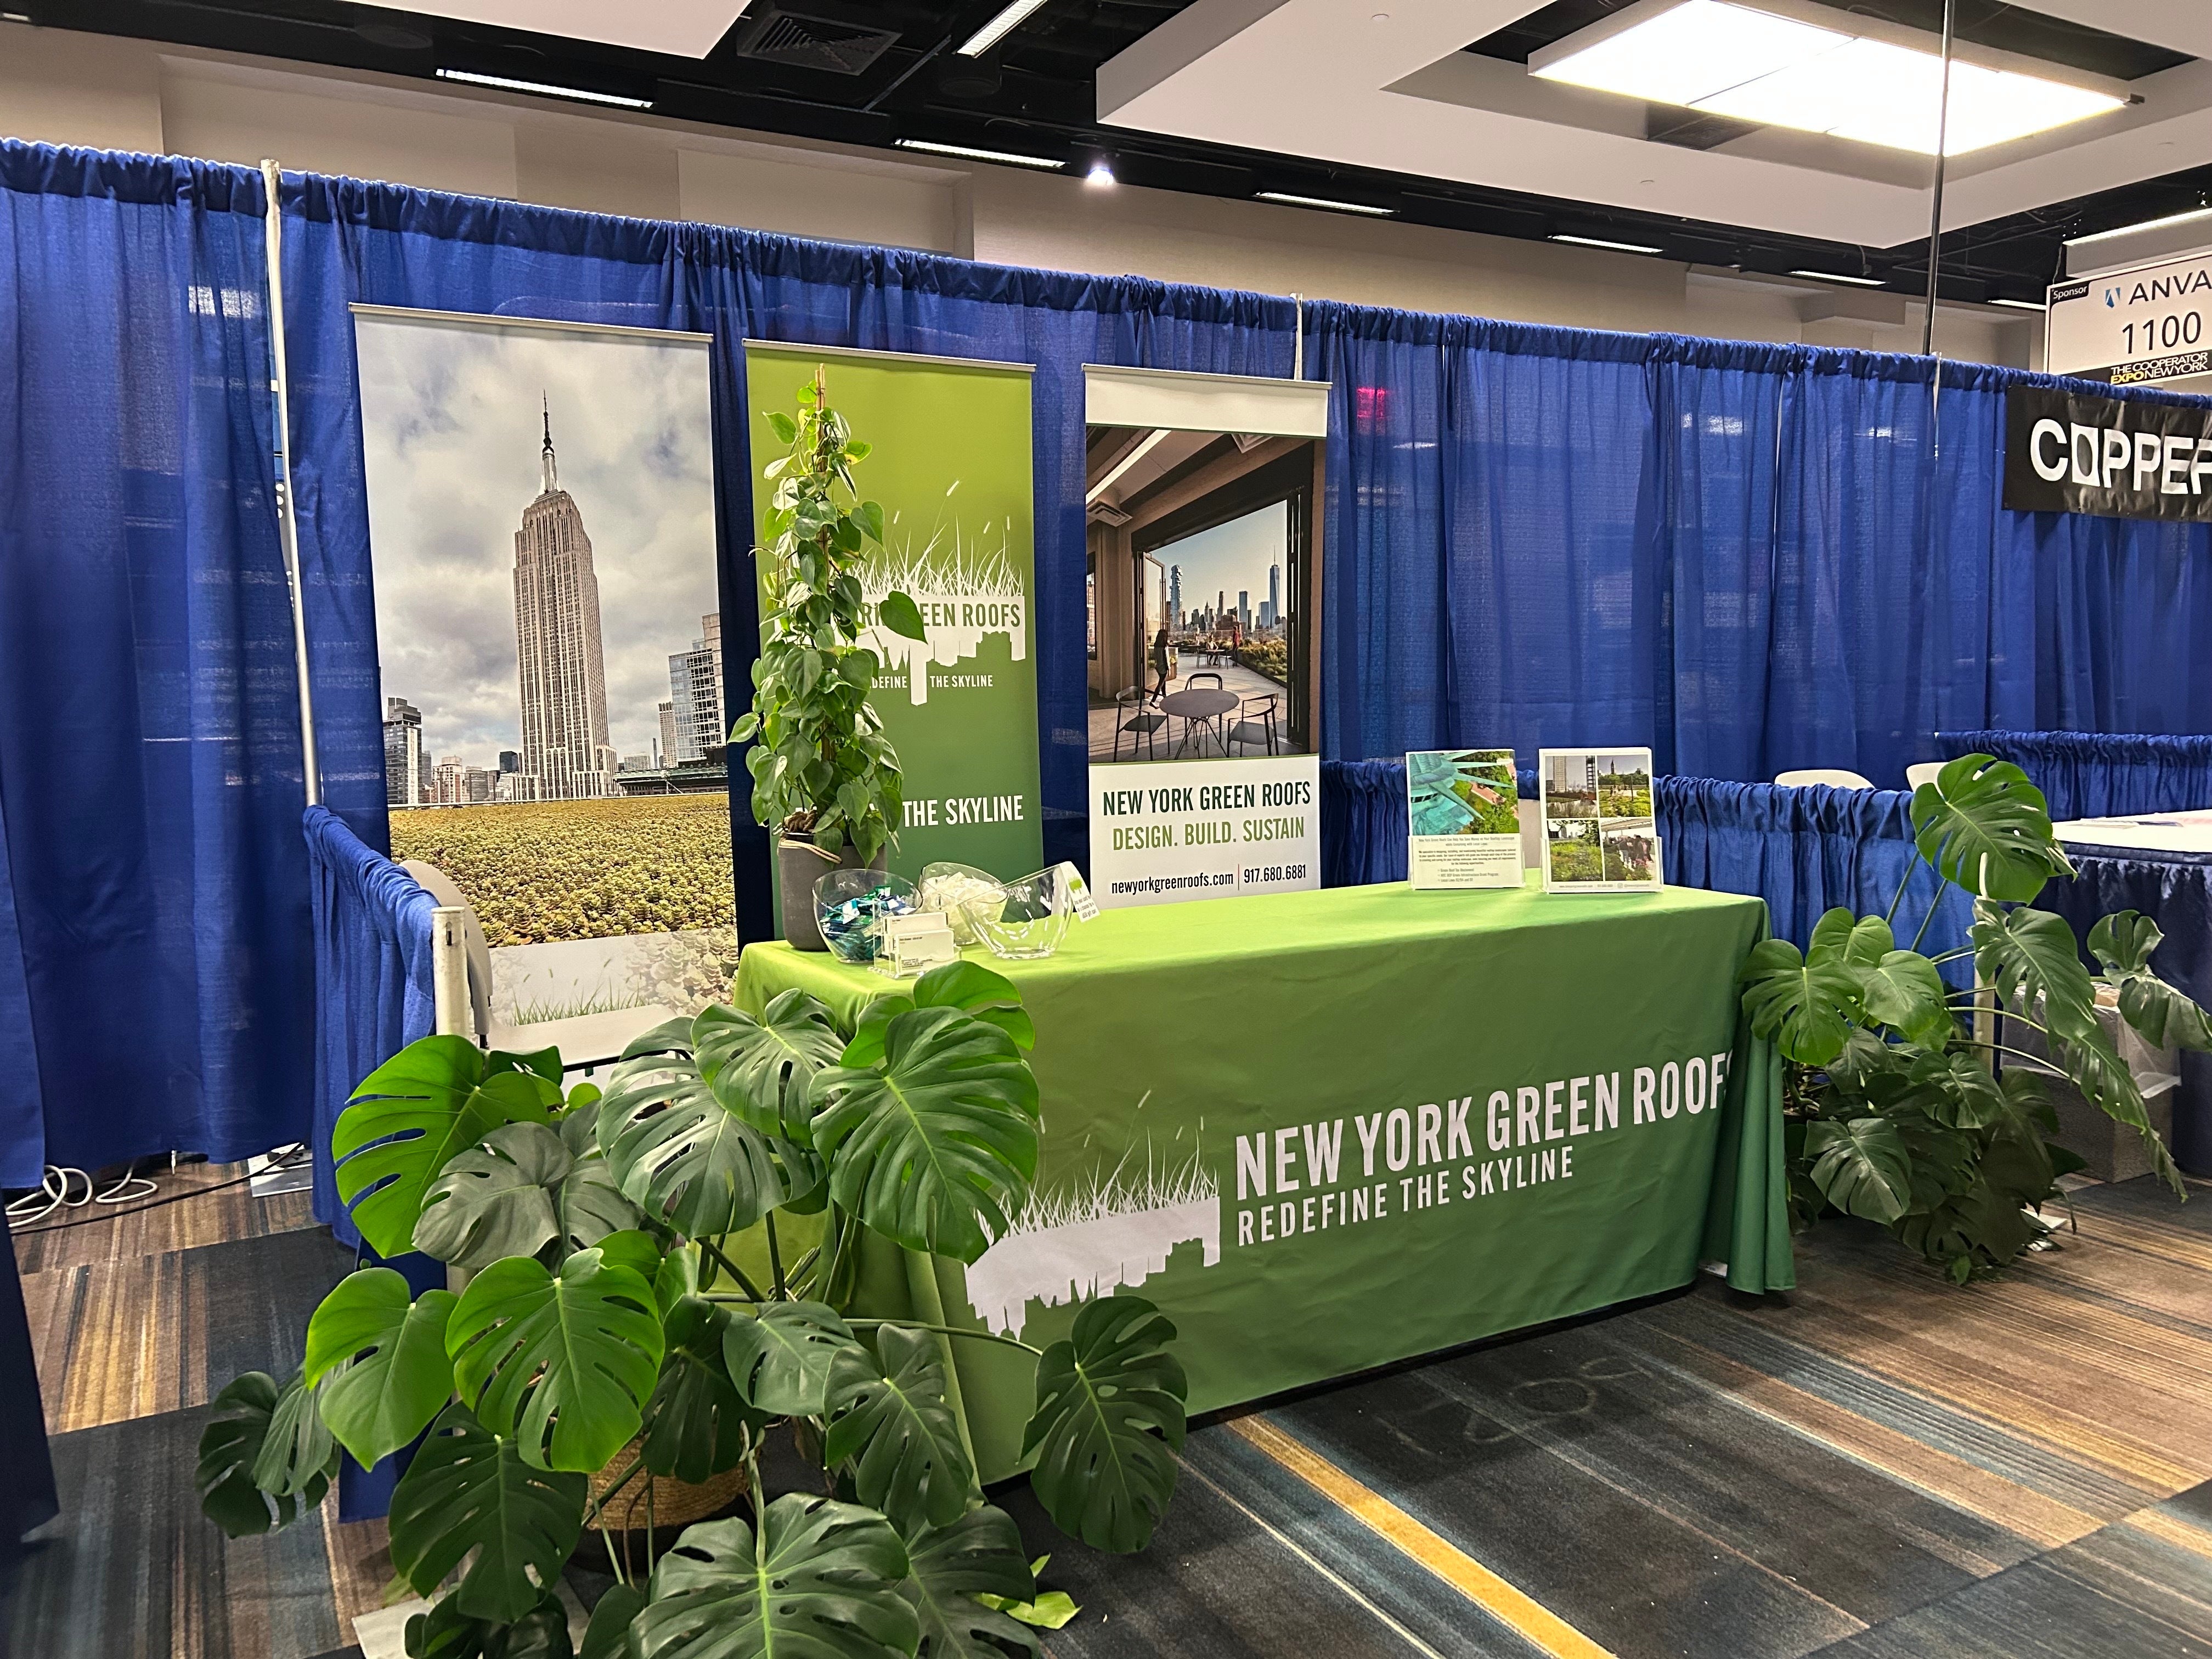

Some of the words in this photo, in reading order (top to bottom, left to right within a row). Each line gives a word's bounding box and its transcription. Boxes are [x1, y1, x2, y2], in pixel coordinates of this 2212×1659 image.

[2053, 286, 2087, 300] Sponsor
[2122, 311, 2201, 354] 1100
[2111, 365, 2132, 375] THE
[2132, 352, 2208, 371] COOPERATOR
[2111, 371, 2145, 385] EXPO
[2145, 366, 2174, 379] NEW
[2172, 360, 2208, 375] YORK
[919, 602, 956, 627] EEN
[963, 603, 1020, 627] ROOFS
[872, 676, 907, 689] DEFINE
[930, 675, 949, 688] THE
[951, 675, 993, 687] SKYLINE
[902, 799, 939, 827] THE
[945, 795, 1024, 826] SKYLINE
[1103, 790, 1143, 816] NEW
[1149, 787, 1193, 813] YORK
[1200, 785, 1255, 810] GREEN
[1262, 781, 1311, 807] ROOFS
[1113, 825, 1178, 851] DESIGN.
[1185, 821, 1237, 845] BUILD.
[1243, 817, 1304, 842] SUSTAIN
[1111, 872, 1233, 895] newyorkgreenroofs.com
[1244, 864, 1306, 884] 917.680.6881
[1235, 1119, 1343, 1200] NEW
[1355, 1097, 1475, 1177] YORK
[1487, 1071, 1620, 1152] GREEN
[1633, 1048, 1733, 1125] ROOF
[1238, 1182, 1387, 1248] REDEFINE
[1400, 1170, 1451, 1212] THE
[1462, 1146, 1574, 1200] SKYLINE
